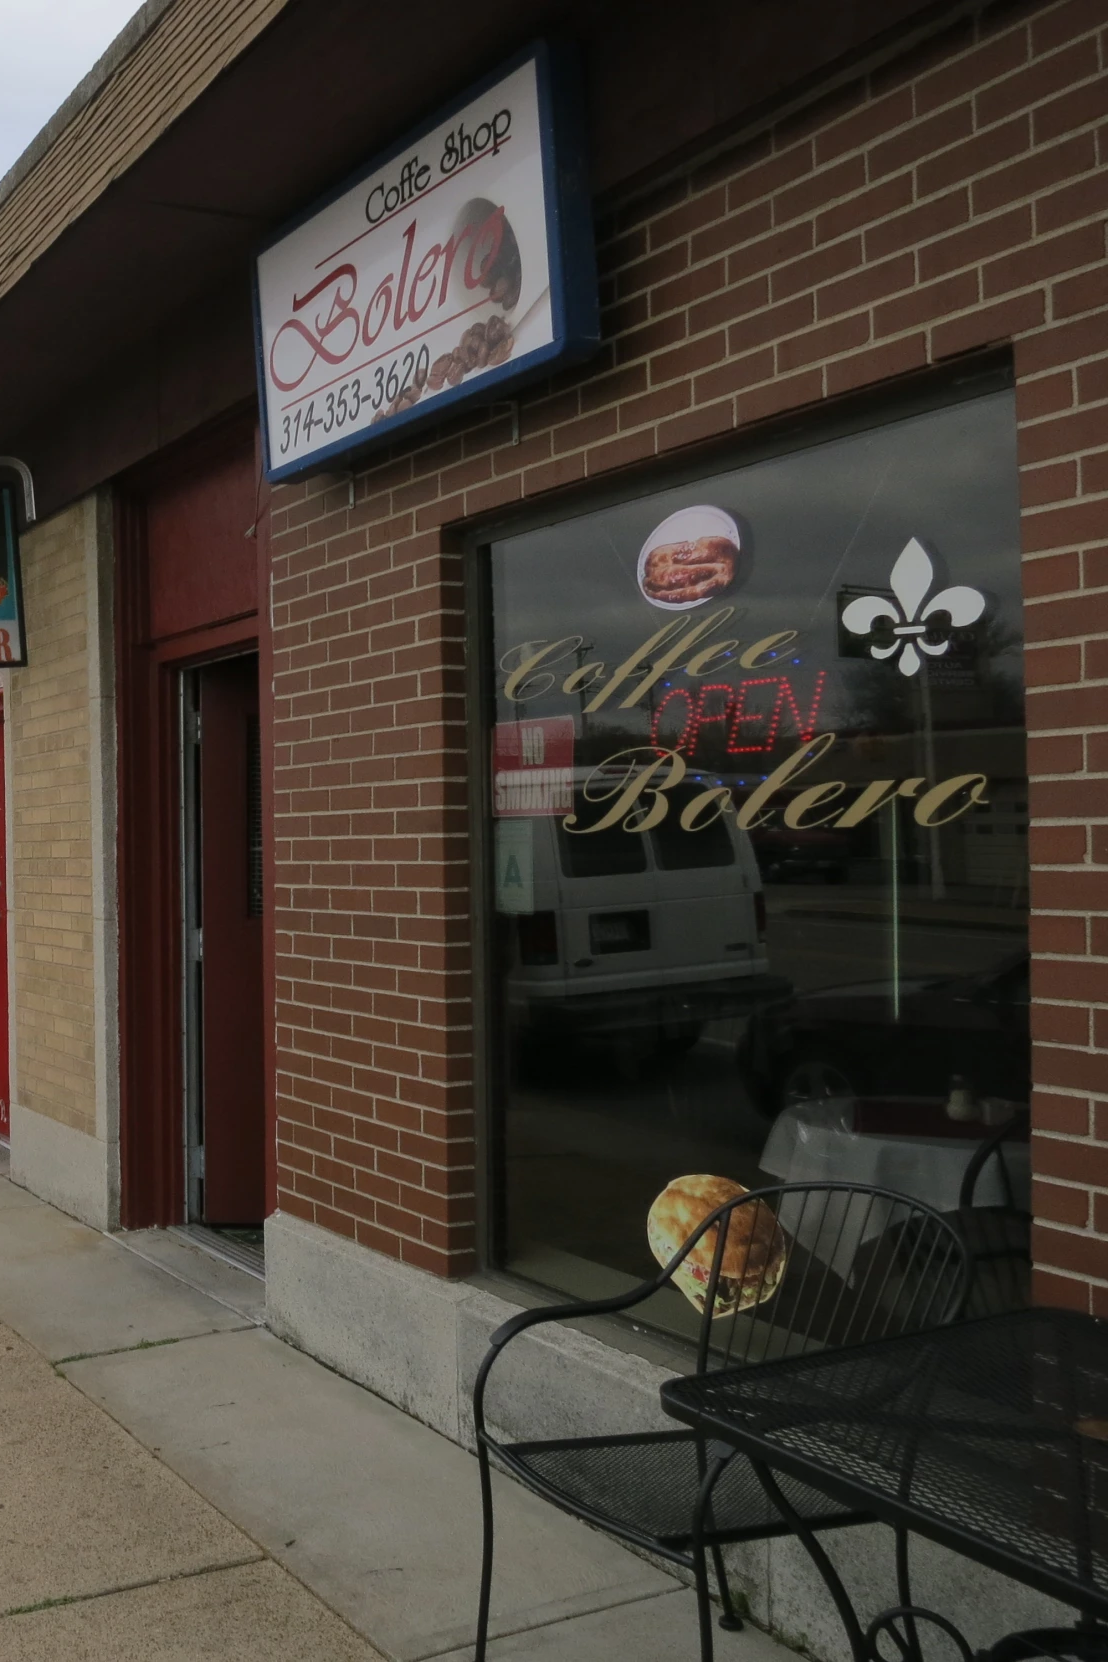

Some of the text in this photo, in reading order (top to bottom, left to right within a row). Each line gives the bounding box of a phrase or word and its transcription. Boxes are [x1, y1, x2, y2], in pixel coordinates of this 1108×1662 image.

[365, 108, 512, 224] Coffe Shop
[269, 205, 506, 393] Bolero
[279, 343, 430, 454] 314-353-3620
[499, 606, 798, 713] Coffee
[521, 726, 545, 766] NO
[651, 671, 826, 757] OPEN
[495, 768, 573, 810] SMOKING
[562, 733, 990, 834] Bolero
[503, 854, 524, 888] A
